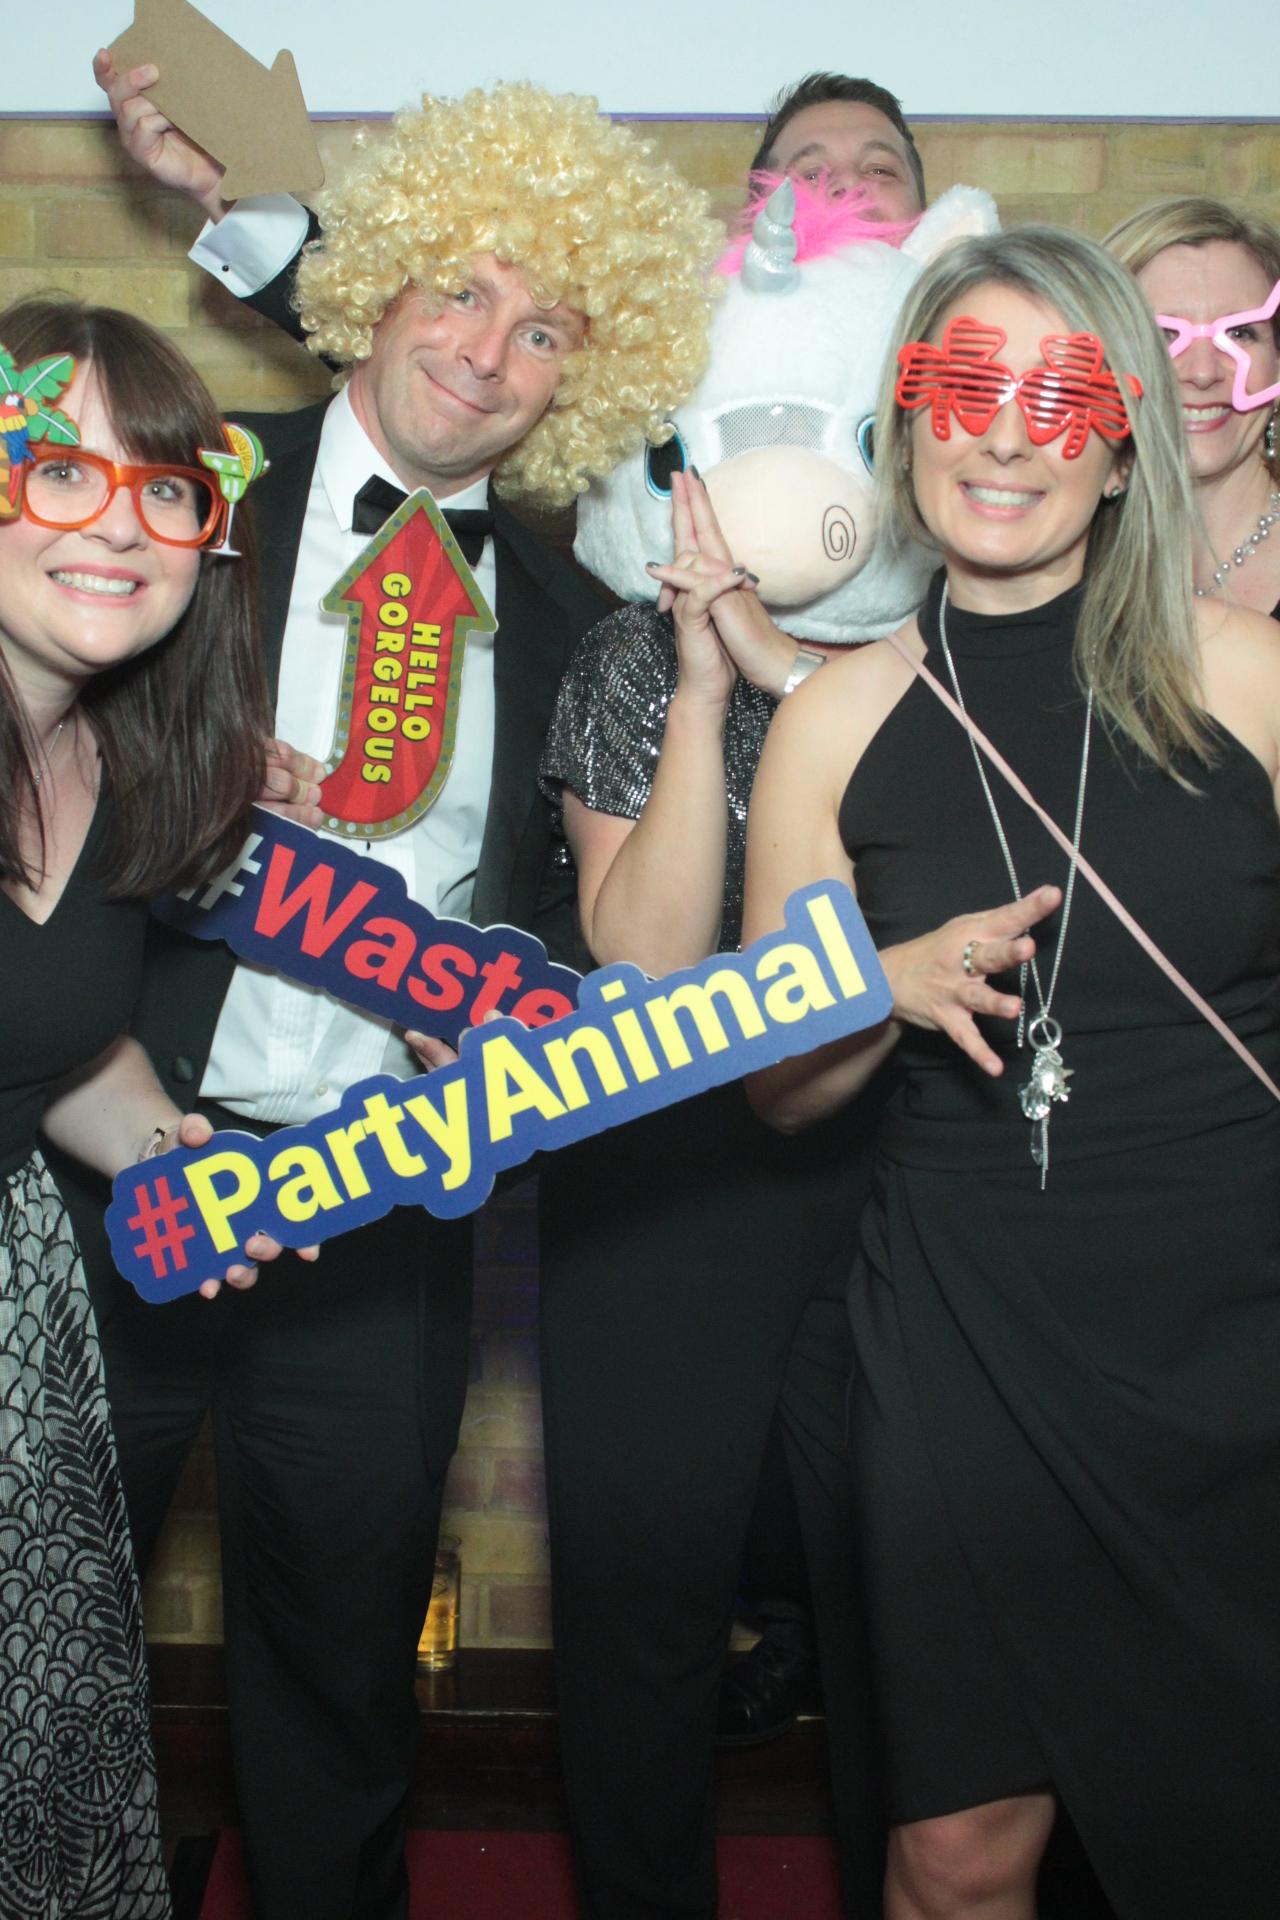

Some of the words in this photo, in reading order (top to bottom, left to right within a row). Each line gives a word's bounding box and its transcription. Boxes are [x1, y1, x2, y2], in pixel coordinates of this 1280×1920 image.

[361, 572, 412, 785] GORGEOUS
[401, 622, 441, 741] HELLO
[127, 895, 869, 1279] #PartyAnimal
